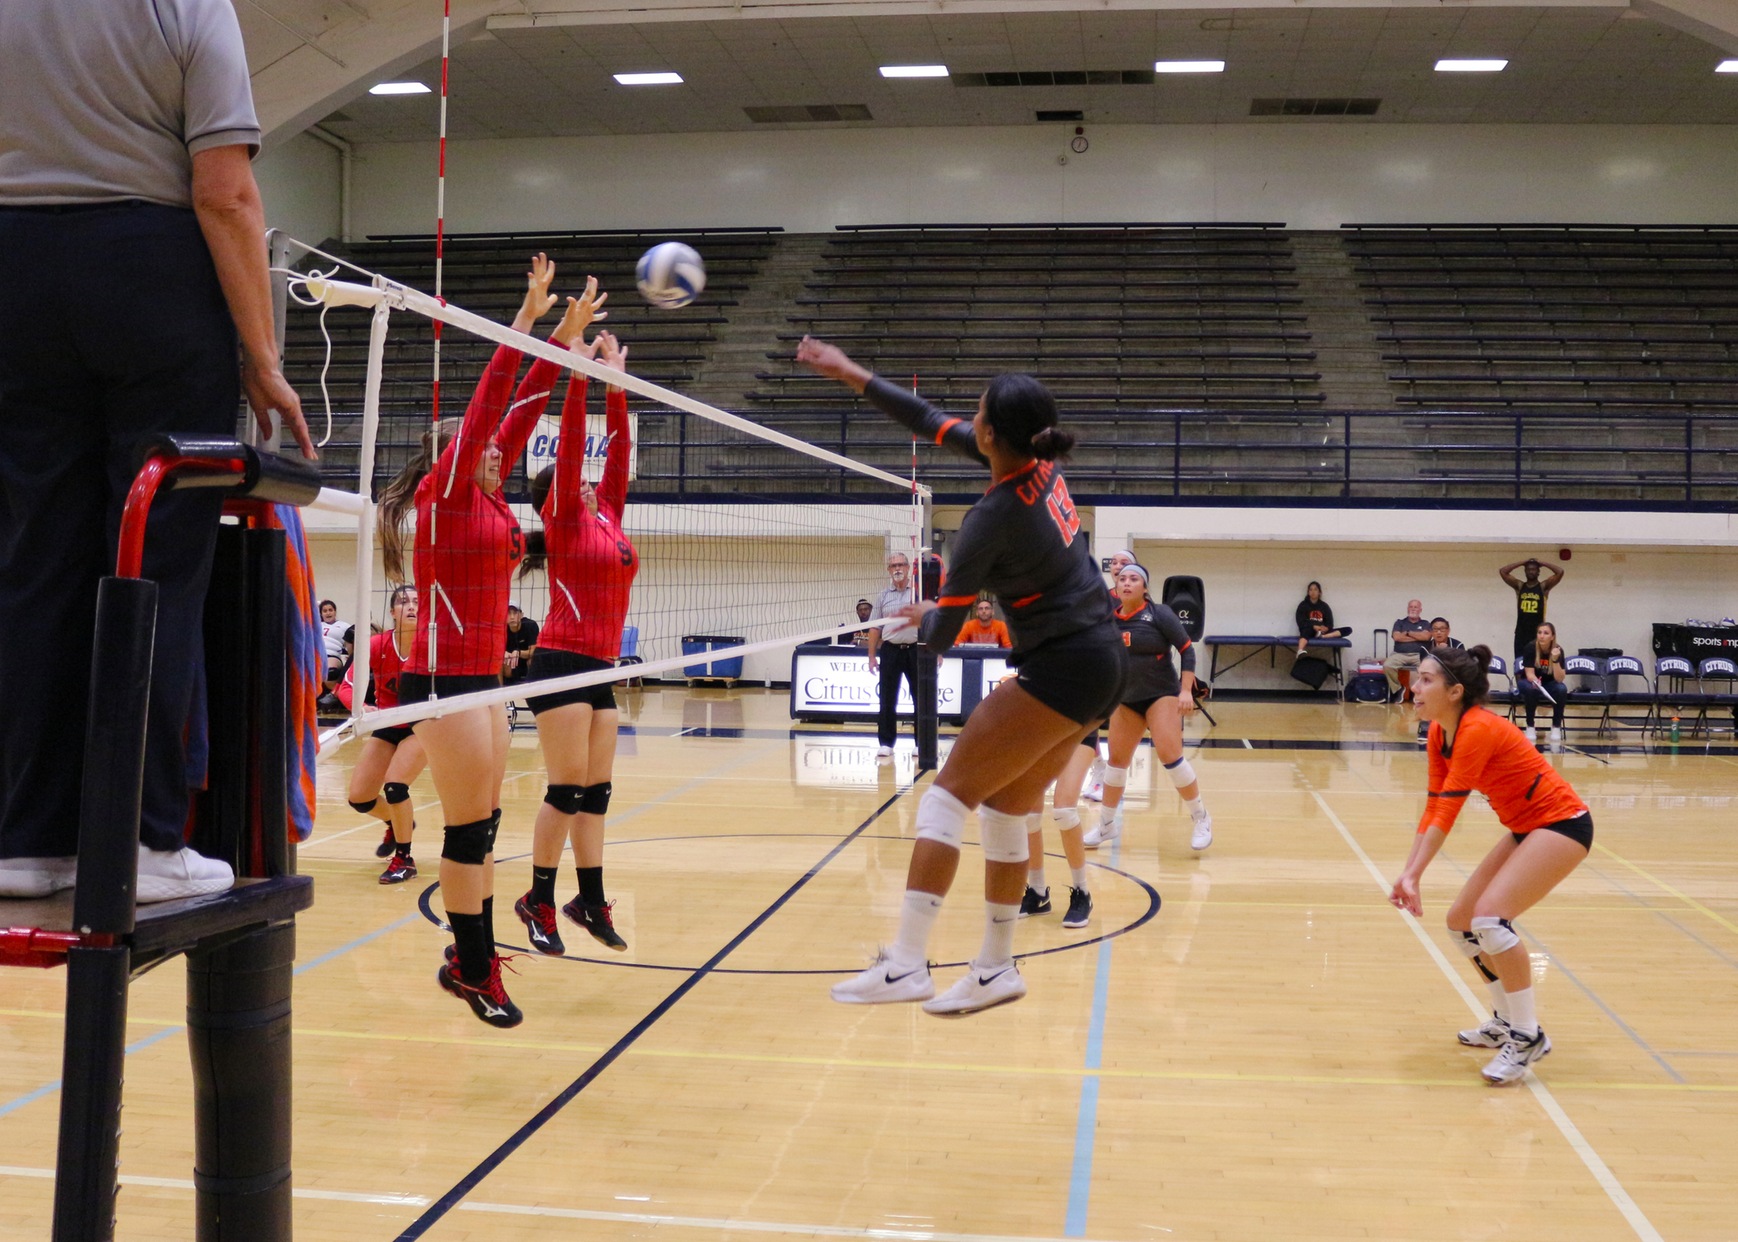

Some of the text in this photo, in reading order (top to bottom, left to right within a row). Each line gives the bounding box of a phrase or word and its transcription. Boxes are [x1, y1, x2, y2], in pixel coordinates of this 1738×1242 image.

[1046, 474, 1080, 548] 13
[509, 527, 521, 560] 5
[616, 540, 633, 566] 9
[323, 628, 330, 636] 7
[1693, 637, 1722, 646] sports
[1566, 658, 1596, 671] CITRUS
[1610, 658, 1639, 671] CITRUS
[1661, 659, 1690, 672] CITRUS
[1705, 660, 1734, 673] CITRUS
[805, 677, 872, 700] Citrus
